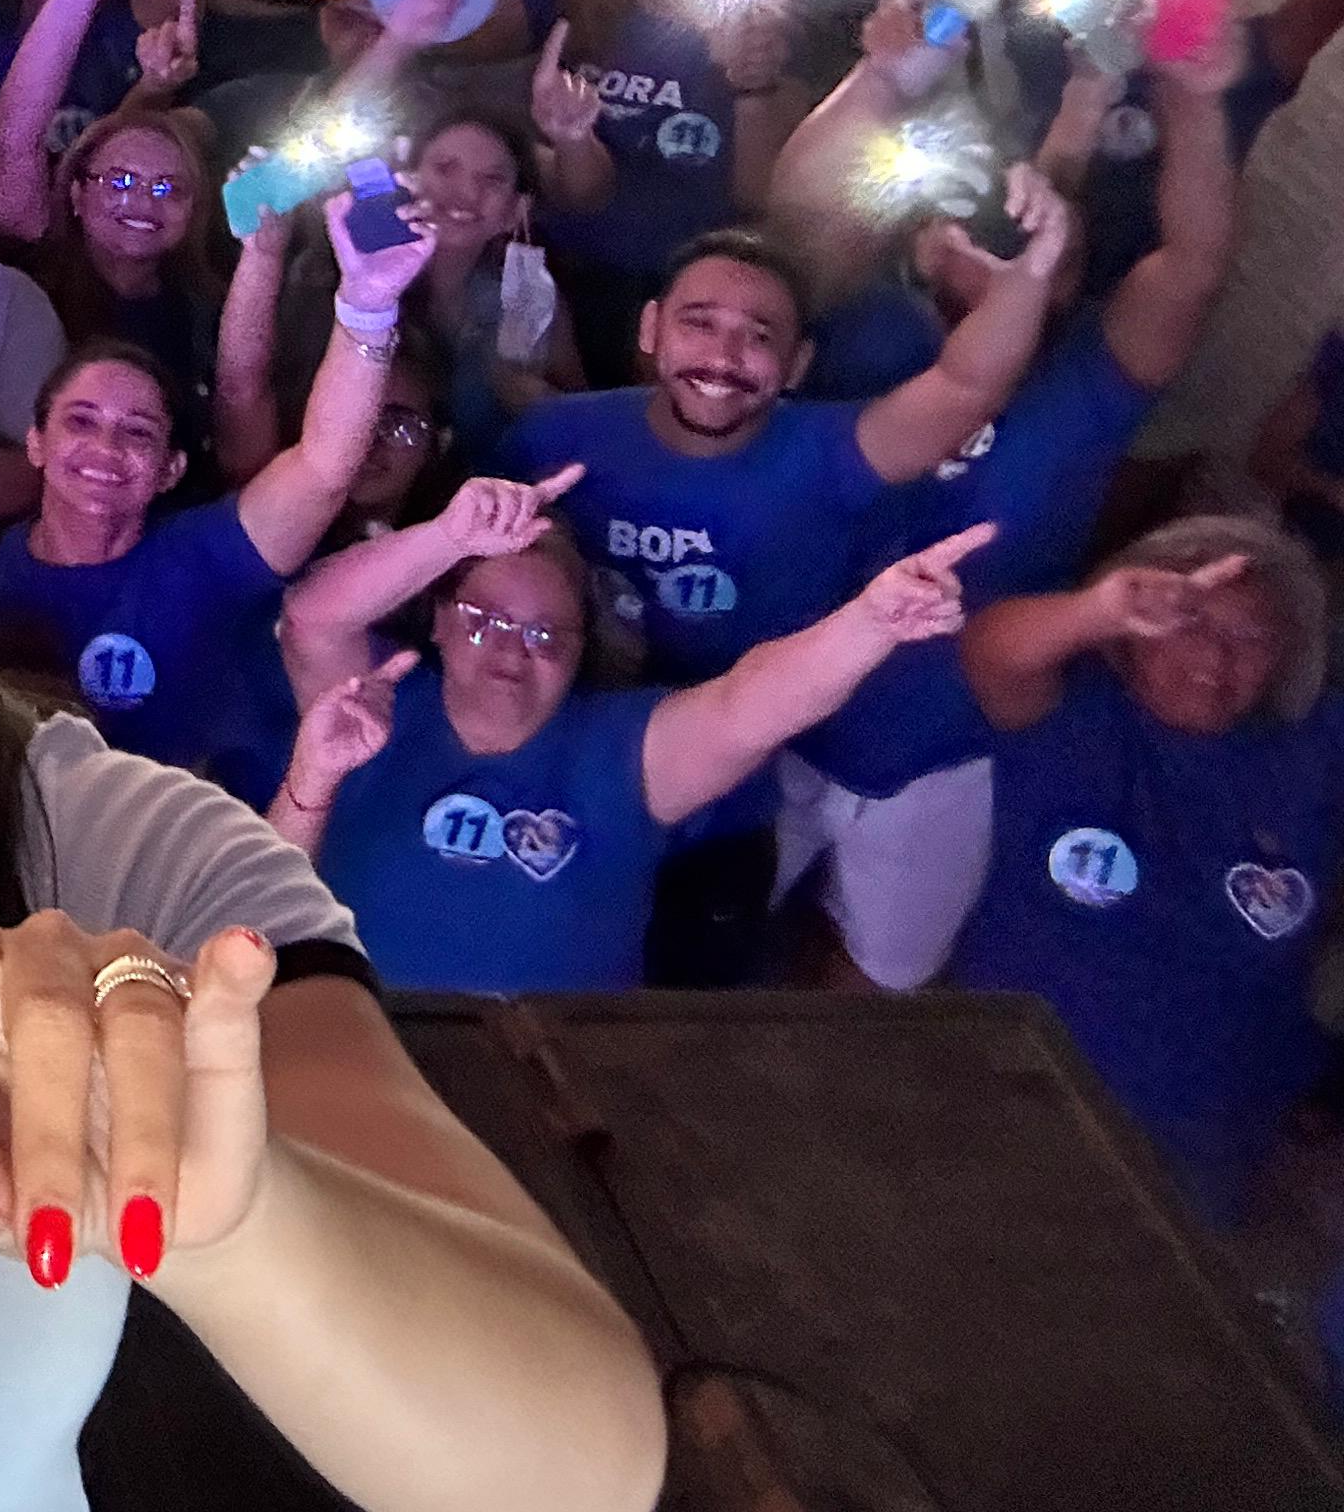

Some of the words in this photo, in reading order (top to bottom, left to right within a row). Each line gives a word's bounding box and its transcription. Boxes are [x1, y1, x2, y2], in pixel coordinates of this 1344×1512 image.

[582, 68, 683, 109] ORA
[677, 574, 718, 608] 11
[95, 647, 136, 692] 11
[444, 808, 490, 852] 11
